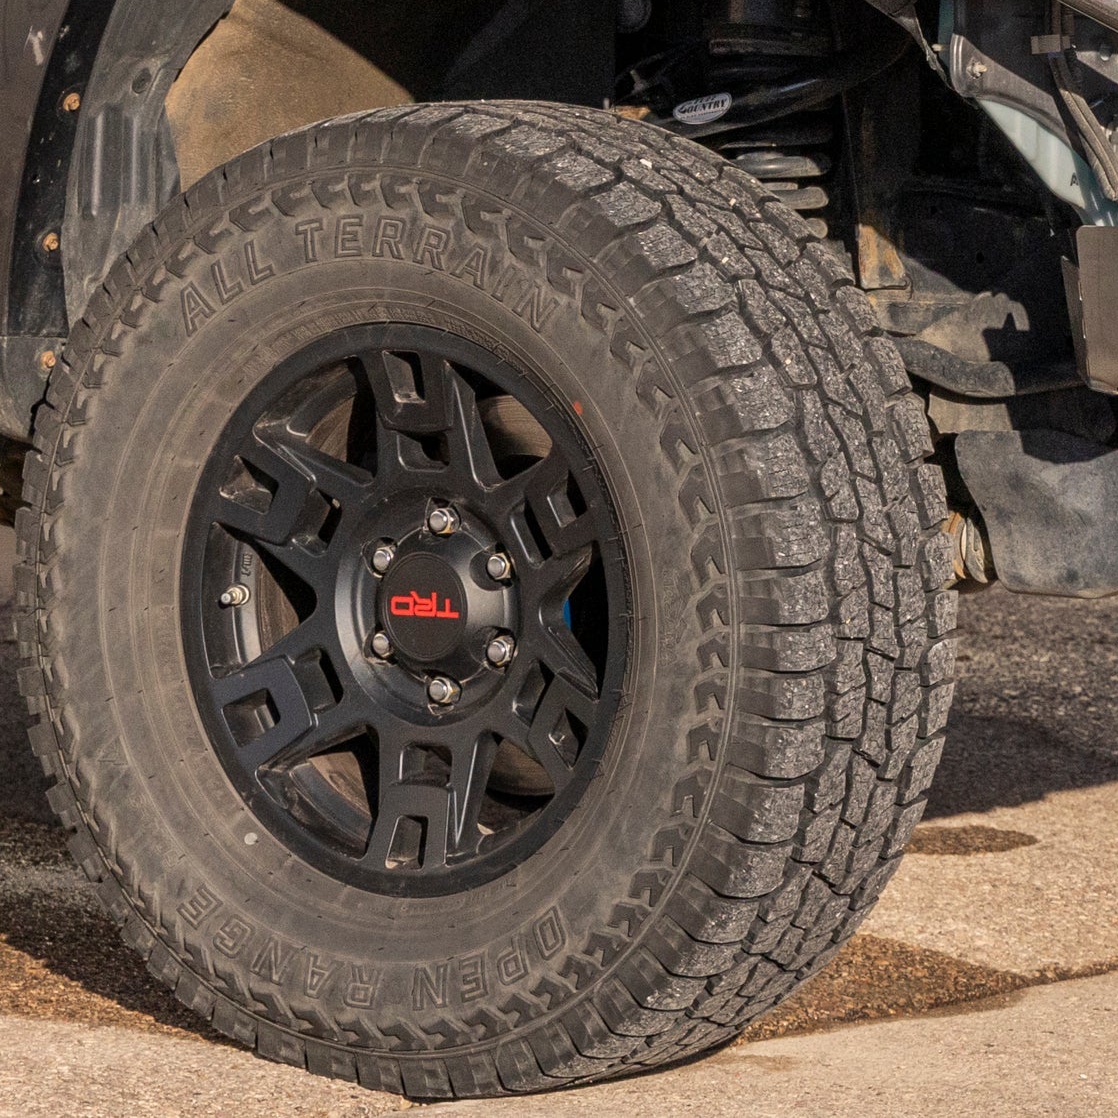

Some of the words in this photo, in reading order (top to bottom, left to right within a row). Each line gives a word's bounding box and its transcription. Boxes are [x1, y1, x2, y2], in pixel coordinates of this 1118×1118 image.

[180, 238, 276, 337] ALL
[295, 213, 558, 332] TERRAIN
[391, 590, 460, 619] TRD
[177, 885, 383, 1009] RANGE
[410, 904, 569, 1011] OPEN
